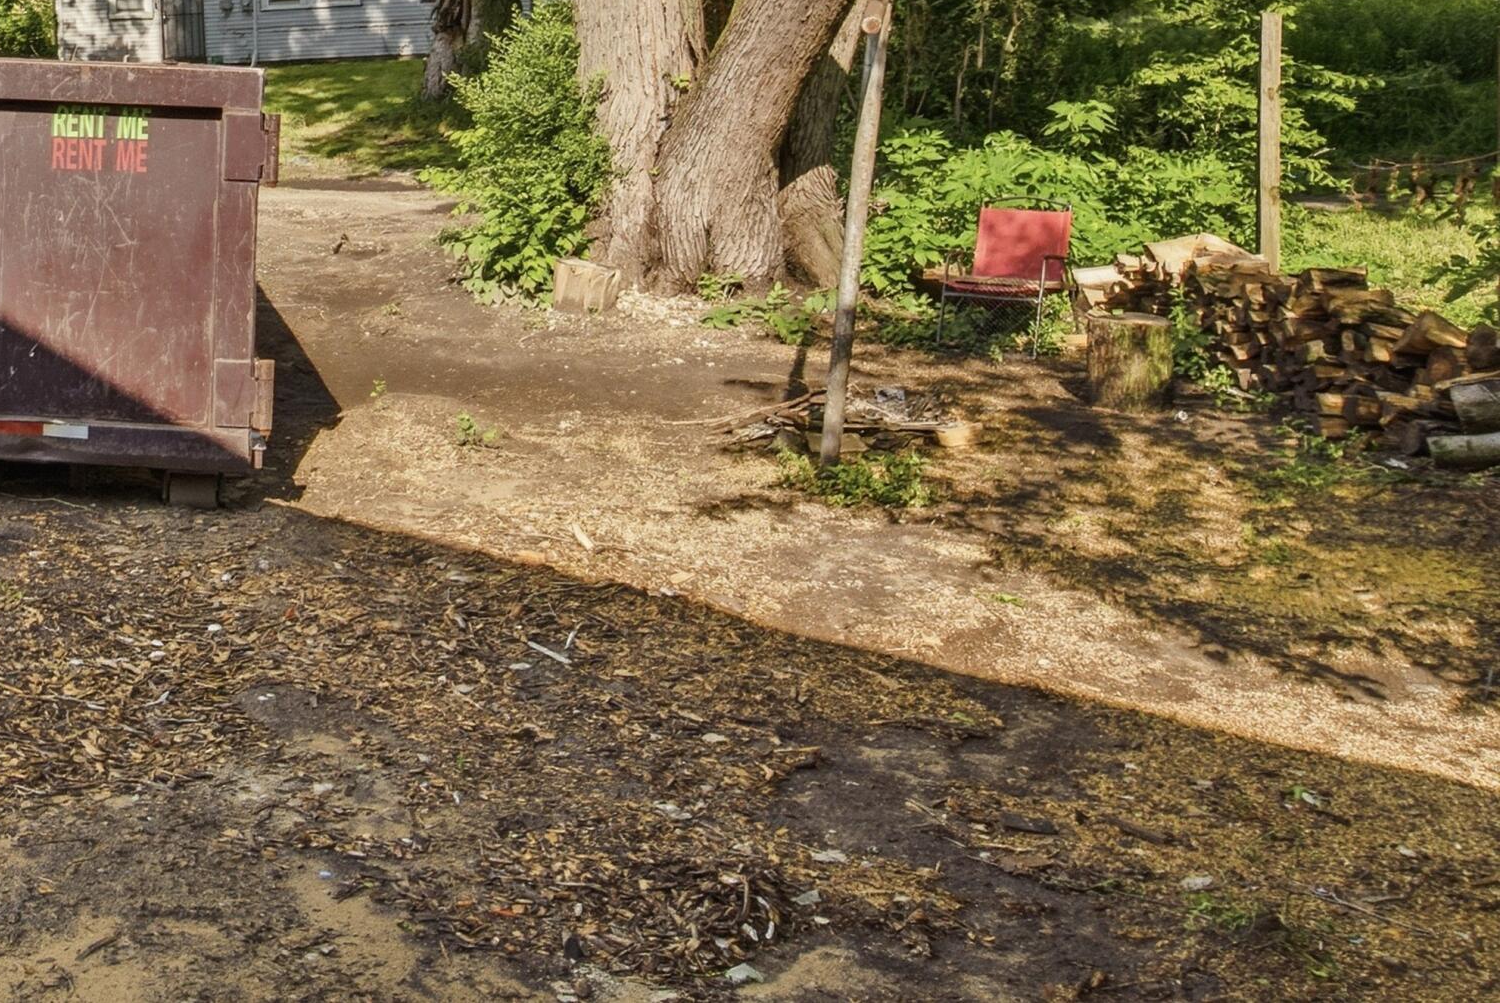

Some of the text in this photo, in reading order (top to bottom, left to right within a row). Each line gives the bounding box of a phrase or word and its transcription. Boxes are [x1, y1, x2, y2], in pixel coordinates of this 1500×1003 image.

[52, 106, 151, 140] RENT ME
[51, 138, 148, 173] RENT ME
